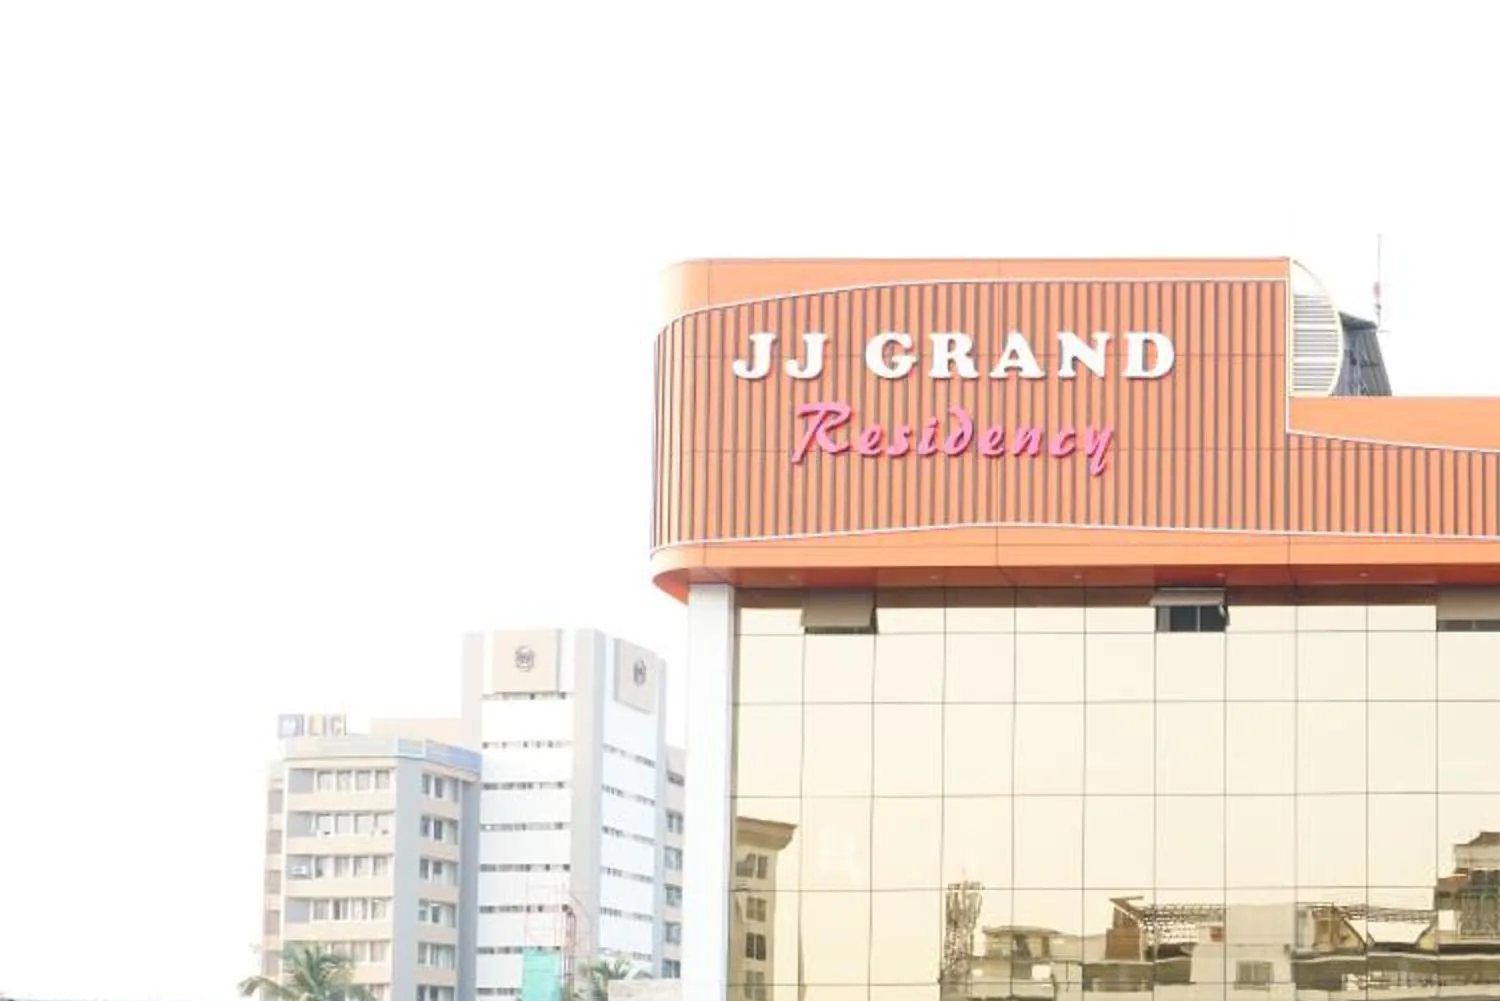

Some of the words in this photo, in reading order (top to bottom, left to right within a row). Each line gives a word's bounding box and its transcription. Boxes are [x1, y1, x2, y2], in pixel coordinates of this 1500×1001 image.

[733, 332, 828, 380] JJ
[864, 332, 1175, 380] GRAND
[790, 401, 1114, 476] Residency
